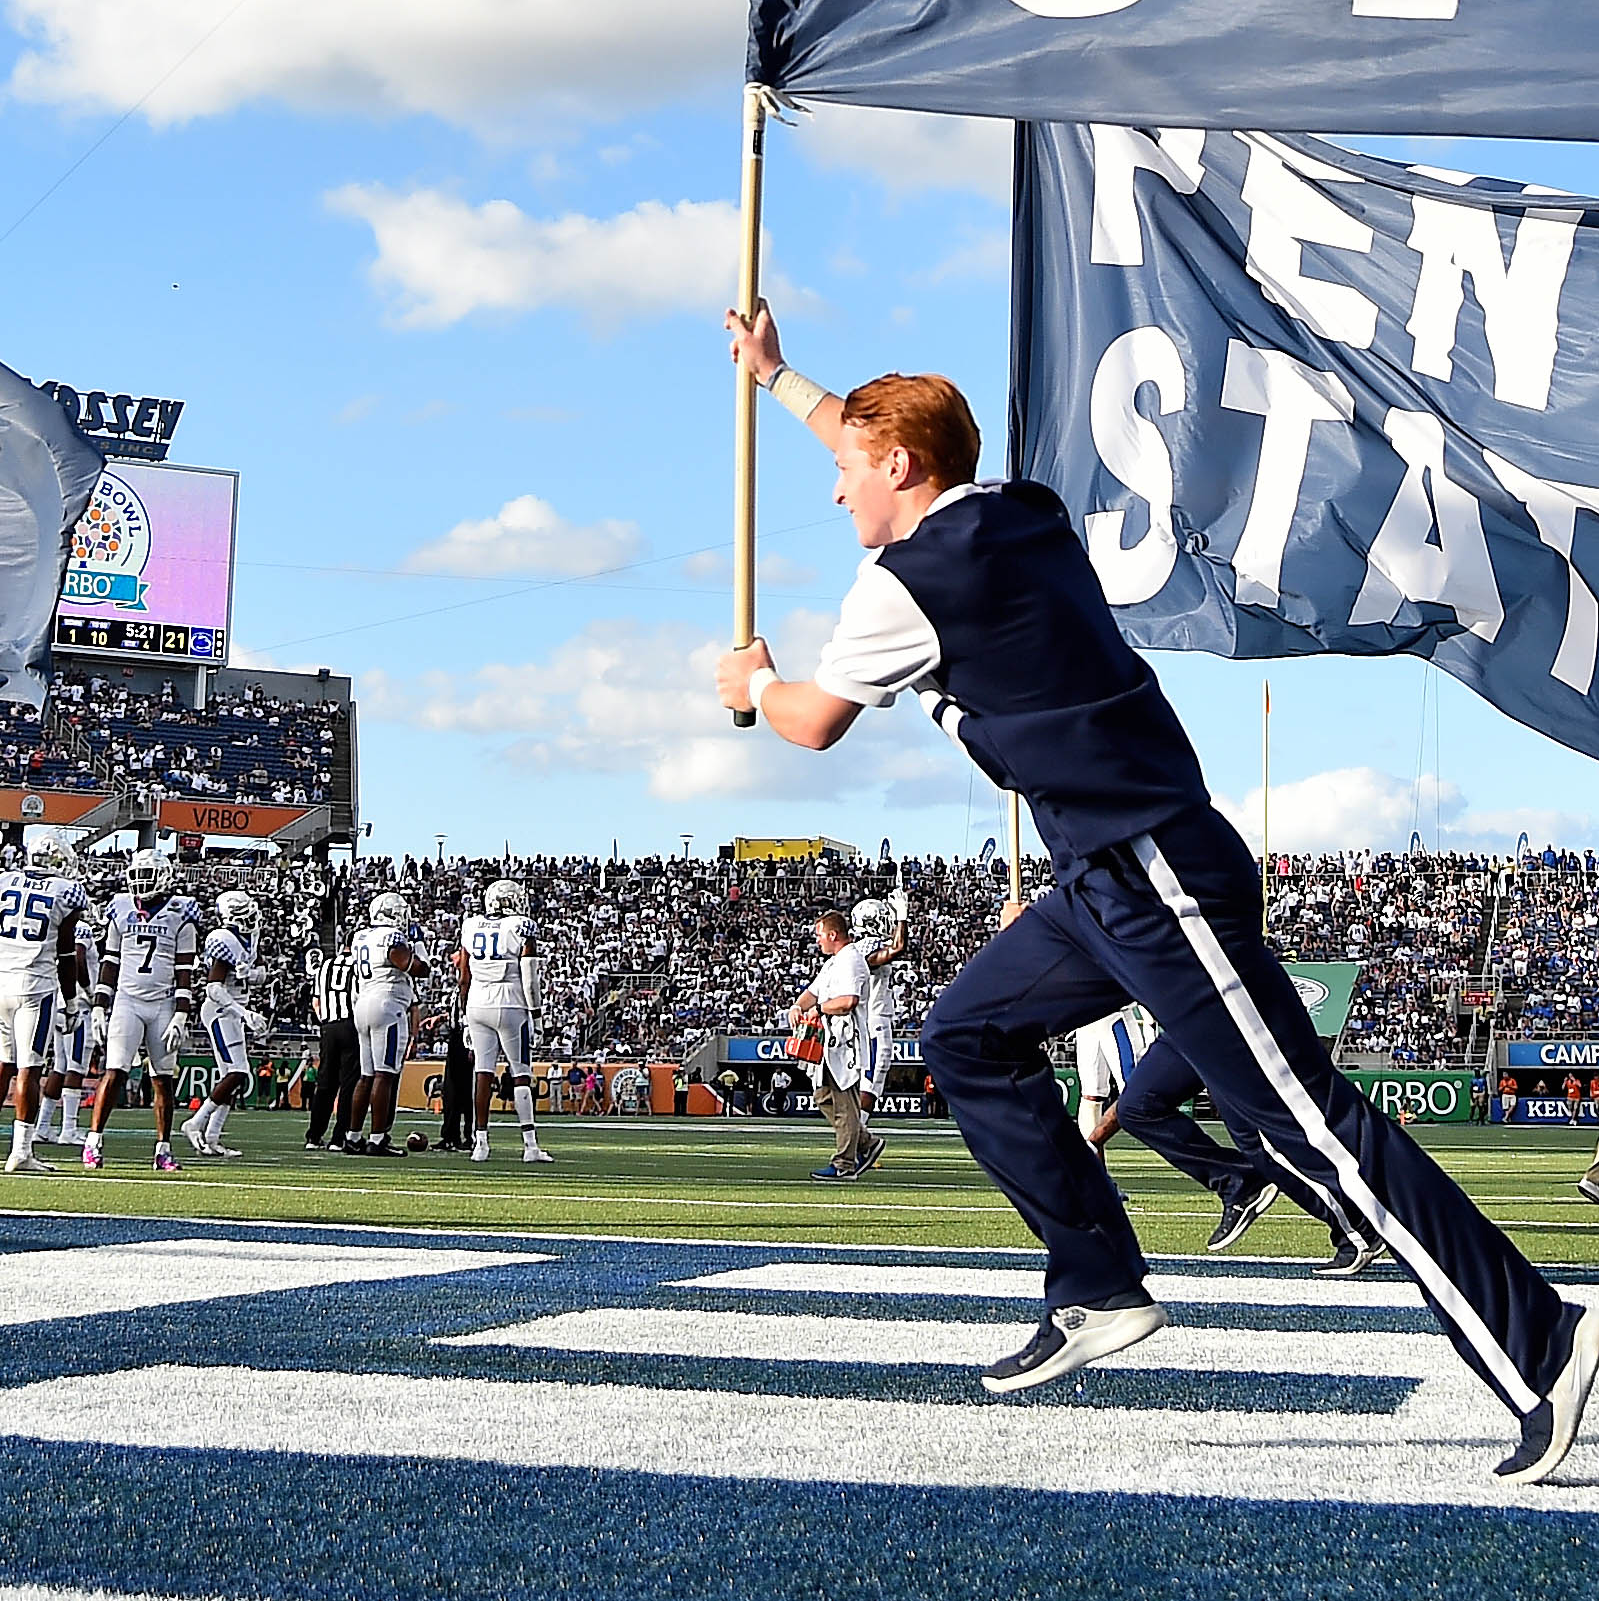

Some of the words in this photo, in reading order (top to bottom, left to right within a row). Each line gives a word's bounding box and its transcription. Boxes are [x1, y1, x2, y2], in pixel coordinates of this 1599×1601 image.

[100, 481, 141, 537] BOWL
[65, 573, 112, 597] RBO
[69, 628, 76, 643] 1
[90, 631, 108, 645] 10
[125, 623, 155, 639] 5:21
[164, 631, 185, 649] 21
[193, 808, 250, 830] VRBO
[0, 890, 54, 942] 25
[136, 935, 158, 974] 7
[472, 932, 503, 961] 91
[872, 1096, 922, 1113] TATE
[1354, 1080, 1455, 1116] VRBO
